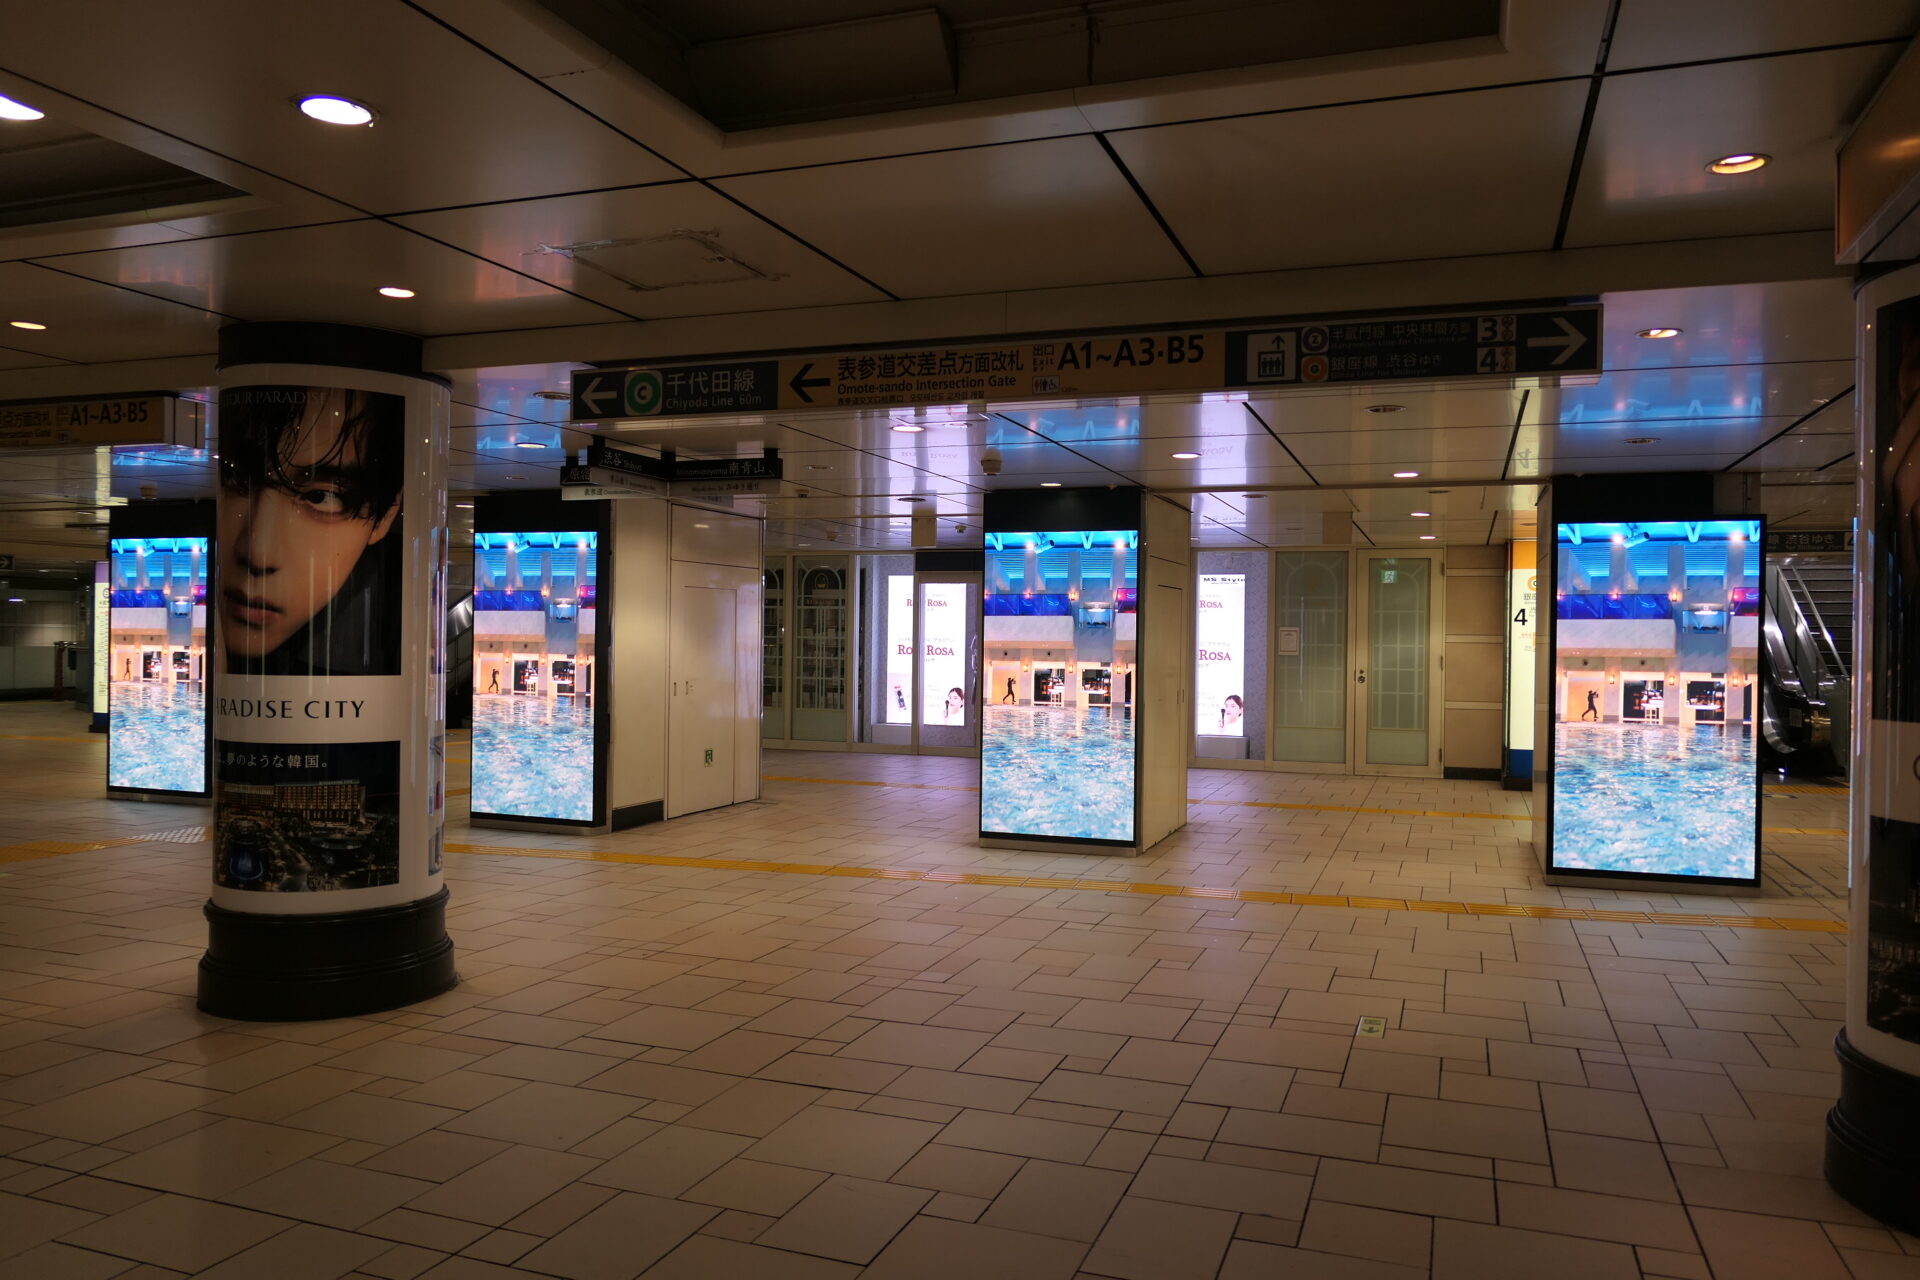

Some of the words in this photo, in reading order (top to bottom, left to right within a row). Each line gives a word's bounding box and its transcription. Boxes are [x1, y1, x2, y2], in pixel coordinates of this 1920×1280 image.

[1482, 318, 1497, 341] 3
[1311, 335, 1319, 344] Z
[1032, 344, 1054, 356] 出口
[838, 350, 1024, 381] 表参道交差点方面改札
[1032, 357, 1054, 366] Exit
[1480, 348, 1499, 371] 4
[666, 368, 755, 396] 千代田線
[838, 379, 913, 395] Omote-sando
[916, 375, 985, 391] Intersection
[988, 374, 1017, 387] Gate
[637, 386, 647, 400] C
[666, 397, 708, 410] Chiyoda
[712, 396, 734, 406] Line
[1514, 608, 1528, 626] 4
[304, 700, 365, 719] CITY
